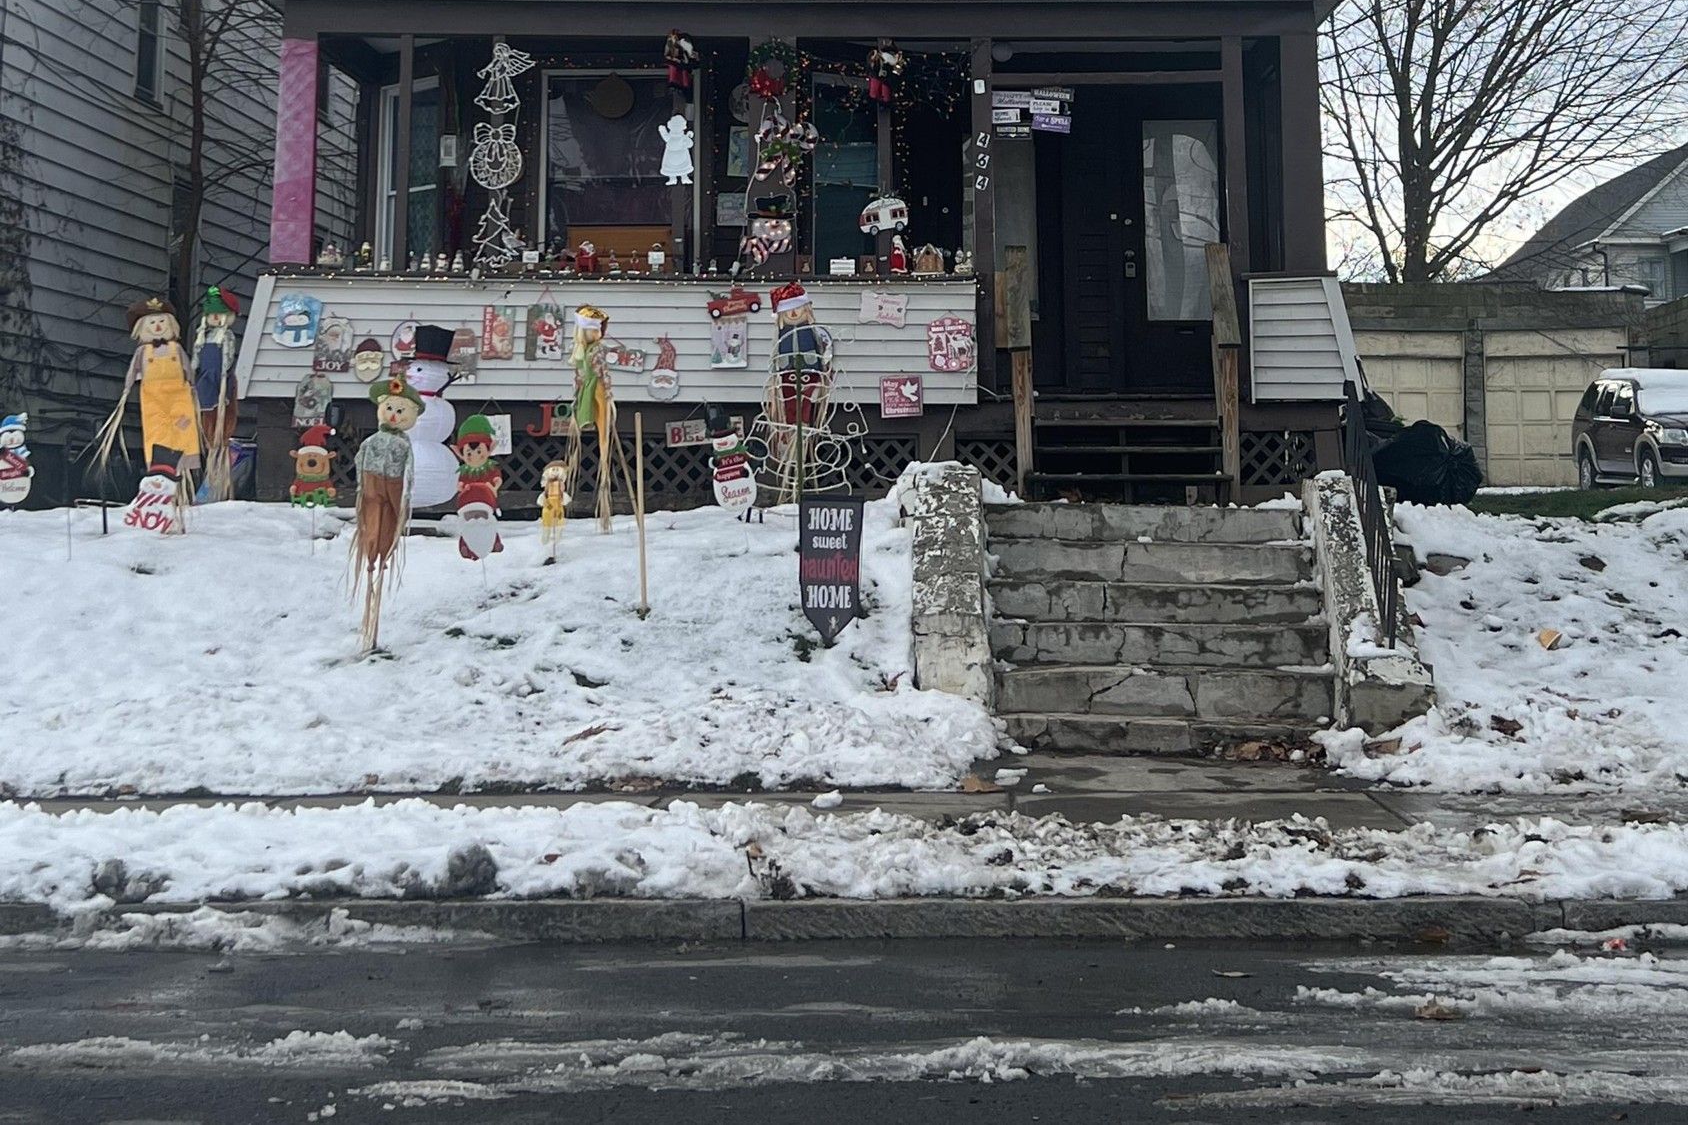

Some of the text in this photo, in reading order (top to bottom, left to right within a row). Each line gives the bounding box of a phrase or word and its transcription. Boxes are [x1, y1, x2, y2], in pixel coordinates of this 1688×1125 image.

[317, 356, 344, 371] JOY
[807, 507, 854, 531] HOME
[812, 533, 848, 549] sweet
[806, 585, 852, 609] HOME
